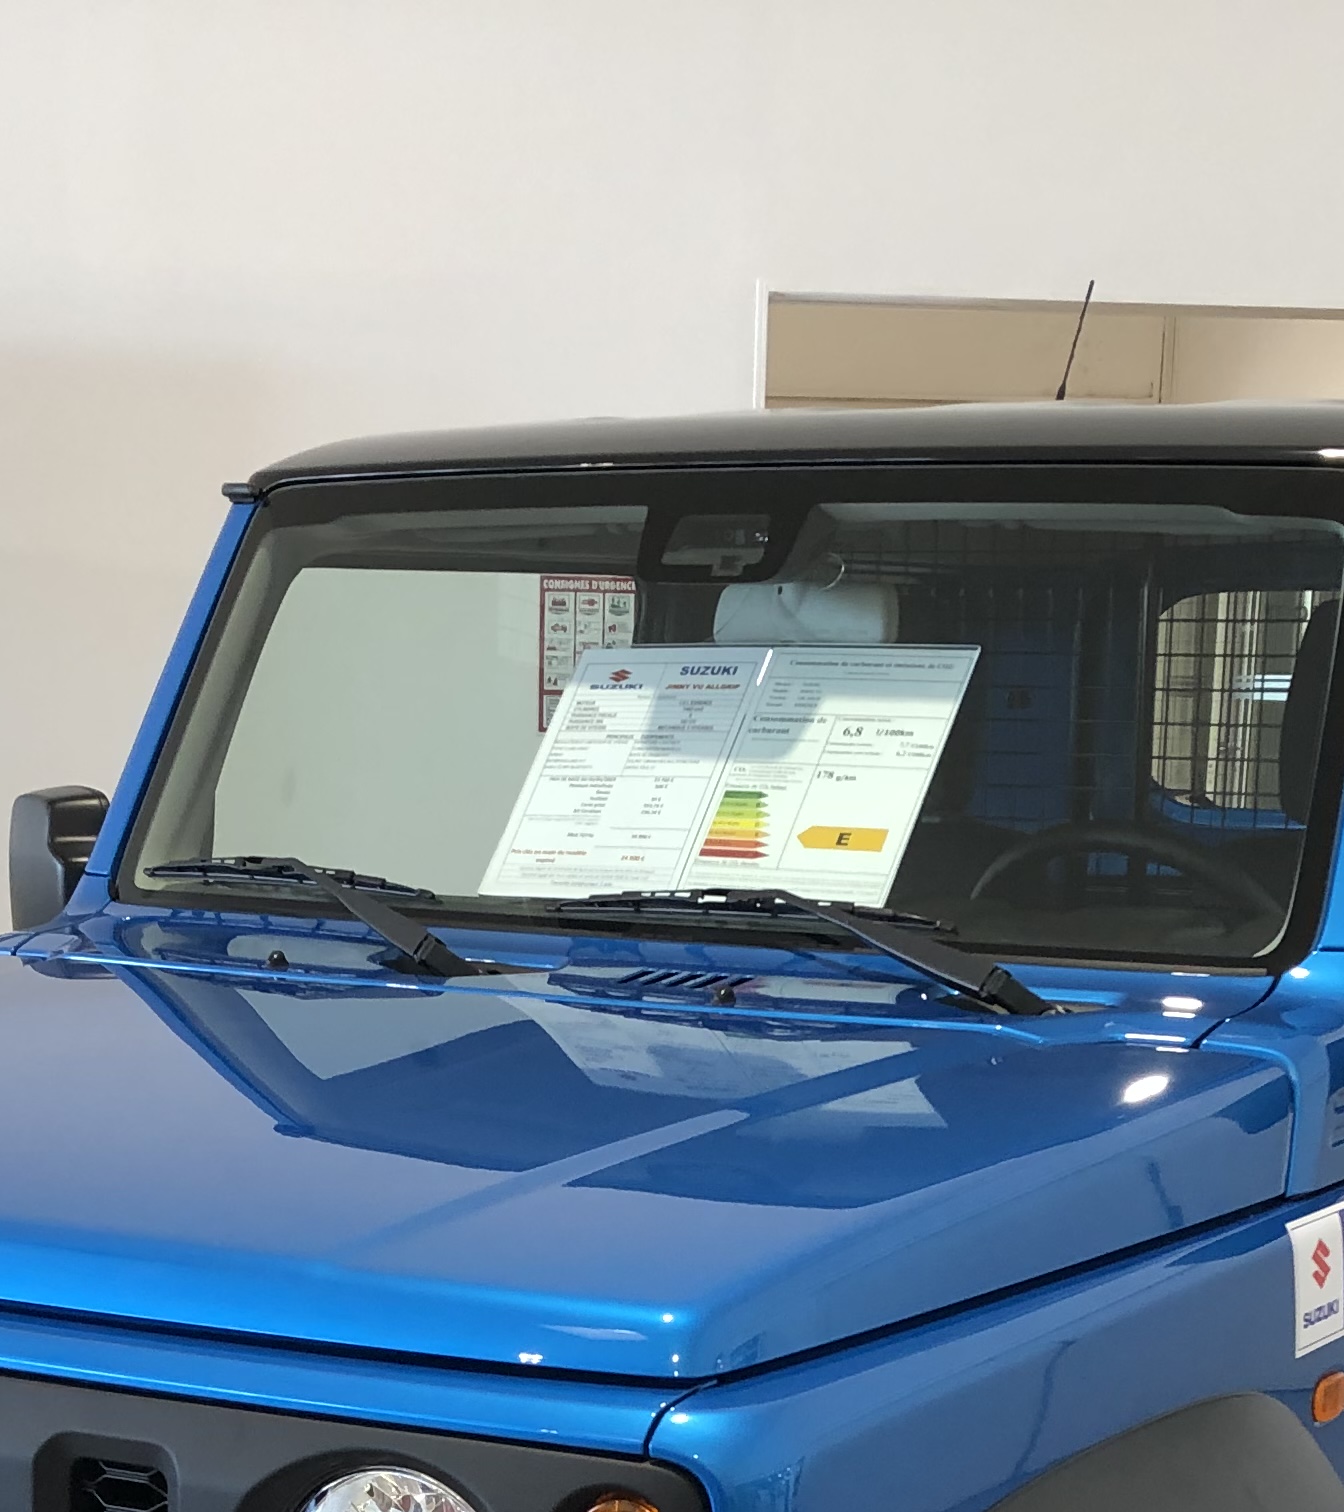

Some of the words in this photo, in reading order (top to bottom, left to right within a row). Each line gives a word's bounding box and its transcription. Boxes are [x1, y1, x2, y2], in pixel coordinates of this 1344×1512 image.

[543, 579, 590, 590] CONSIGNES
[679, 665, 739, 676] SUZUKI
[842, 726, 864, 737] 6,8
[816, 770, 834, 780] 178
[835, 832, 852, 846] E
[1303, 1298, 1340, 1329] SUZUKI
